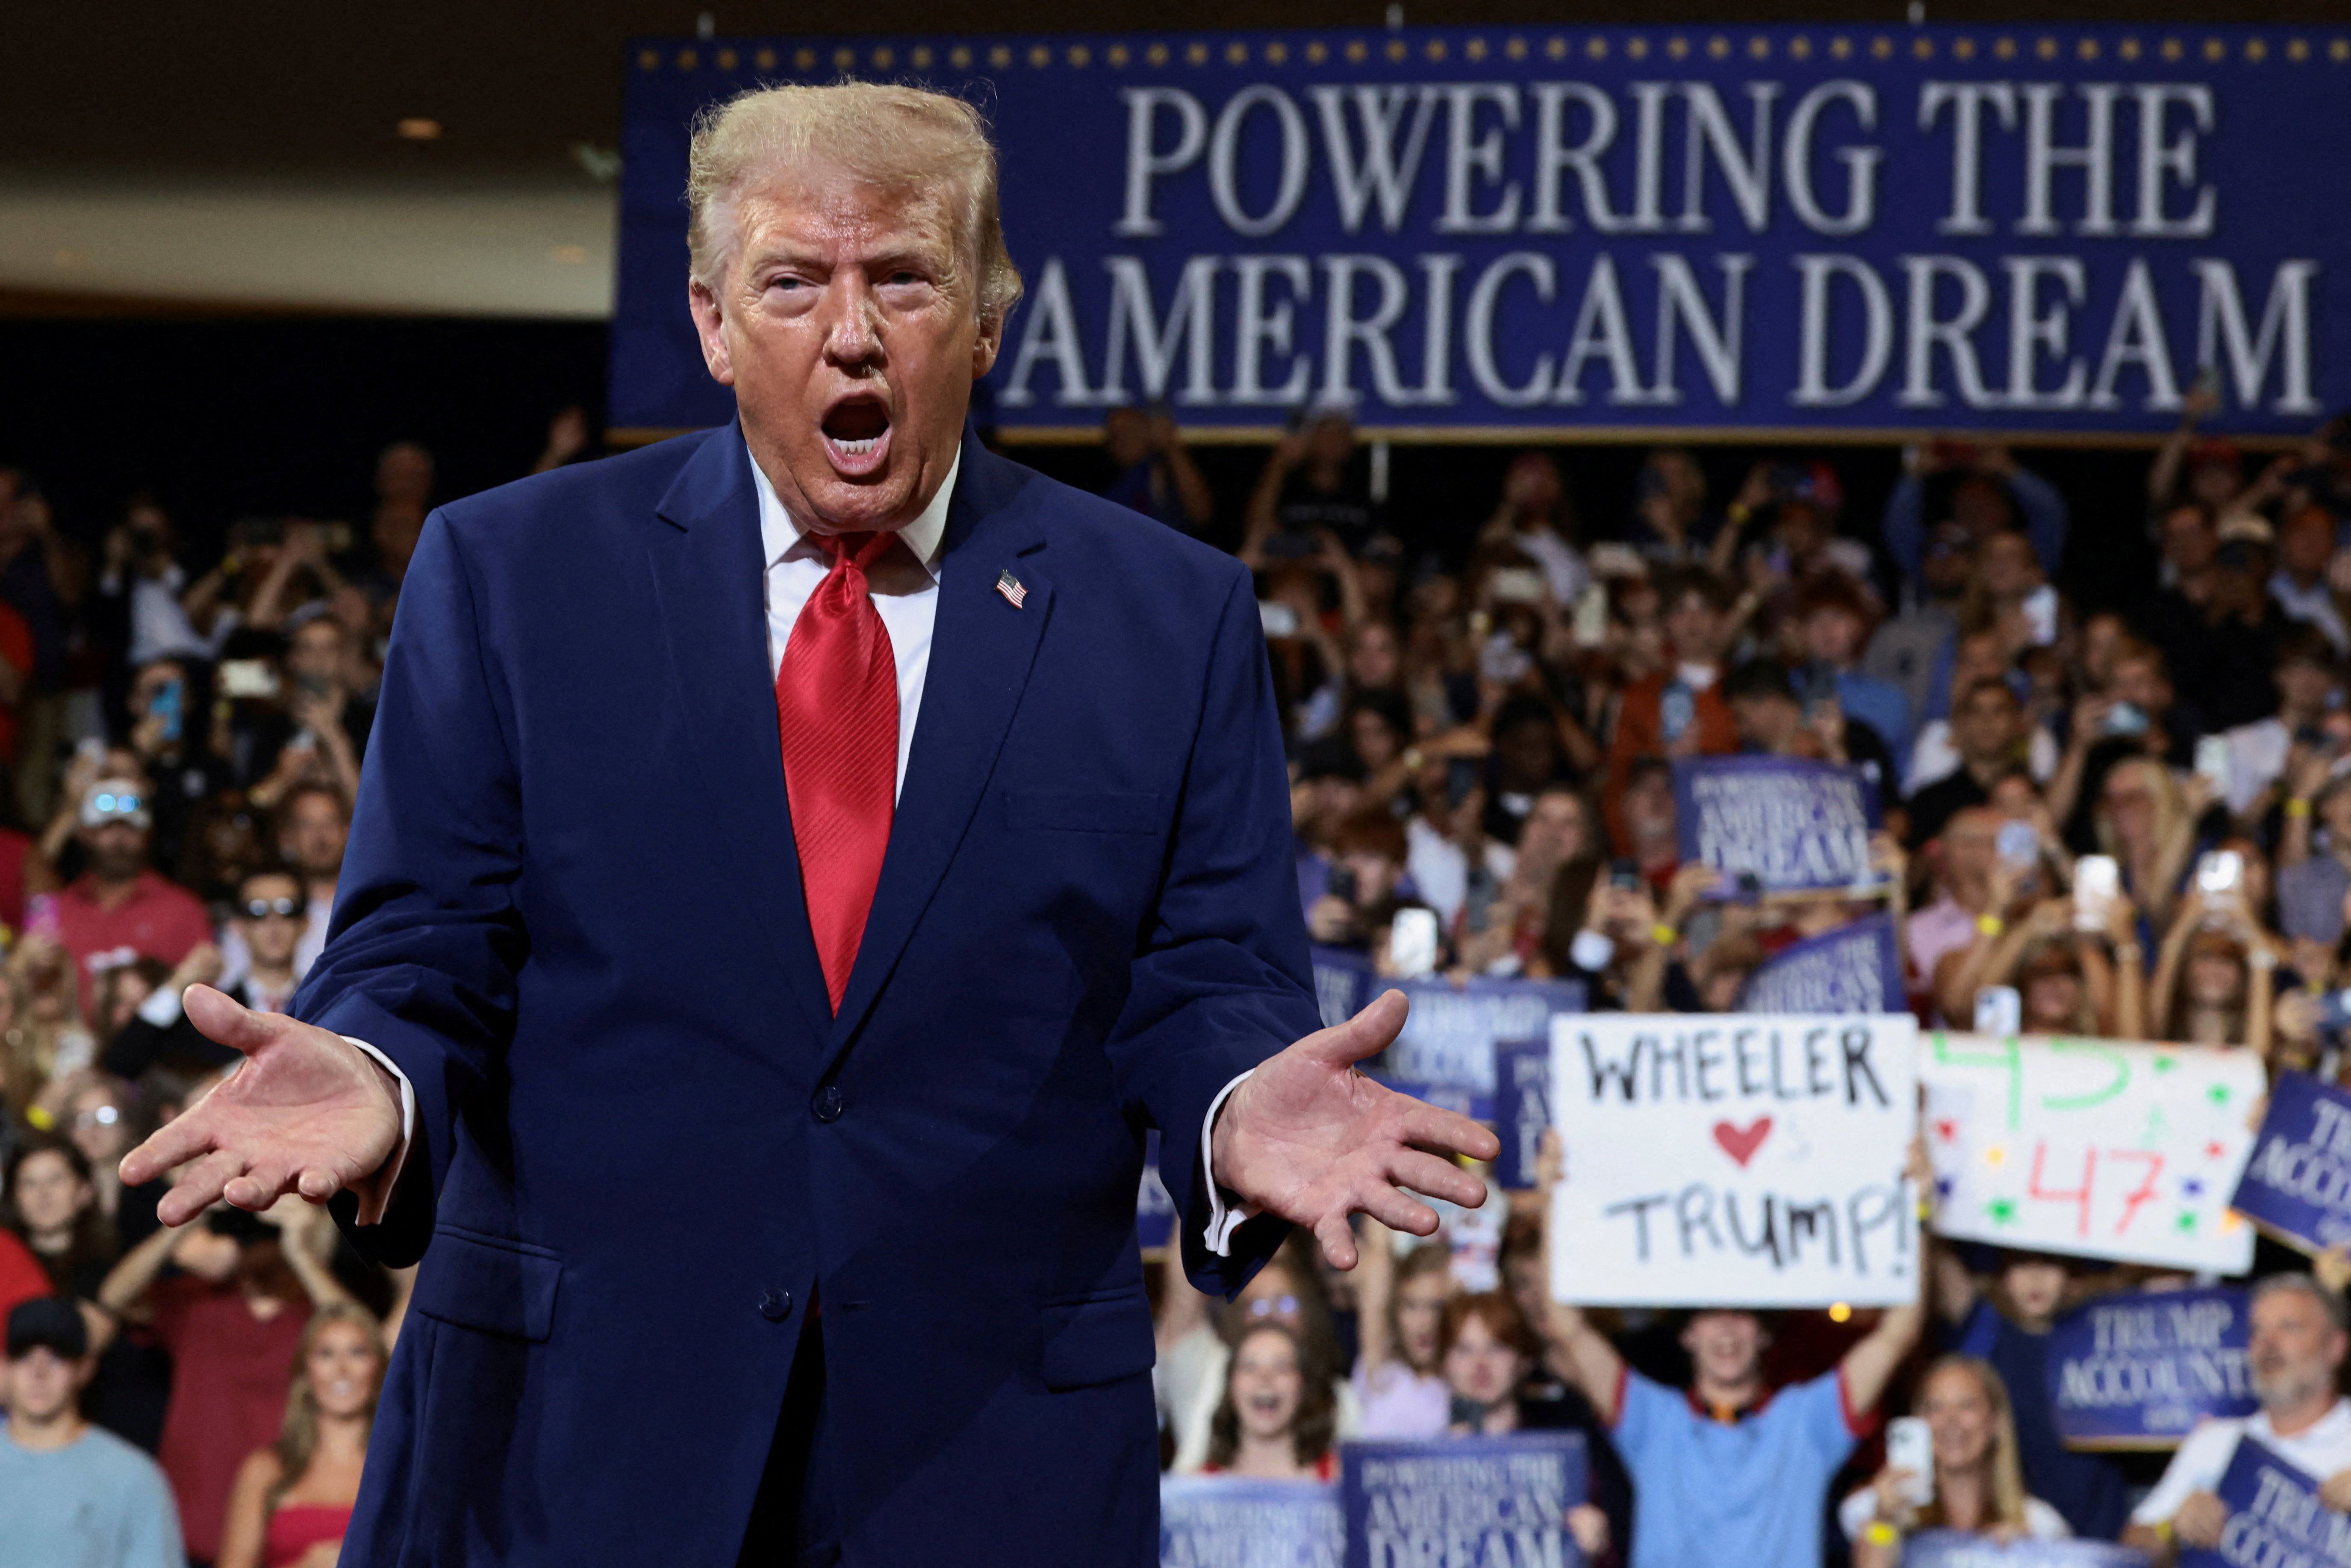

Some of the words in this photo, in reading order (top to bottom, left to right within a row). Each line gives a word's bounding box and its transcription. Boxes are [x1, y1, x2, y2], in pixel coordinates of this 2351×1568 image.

[1113, 80, 1883, 238] POWERING
[1917, 81, 2217, 239] THE
[996, 251, 1755, 409] AMERICAN
[1788, 253, 2322, 415] DREAM
[1580, 1028, 1892, 1109] WHEELER
[2026, 1140, 2166, 1238] 47
[1605, 1176, 1907, 1277] TRUMP!
[2088, 1299, 2234, 1351] TRUMP
[2057, 1346, 2254, 1409] ACCOUNT
[1361, 1456, 1500, 1493] POWERING
[1508, 1452, 1564, 1488] THE
[1365, 1484, 1565, 1536] AMERICAN
[1366, 1524, 1565, 1568] DREAM
